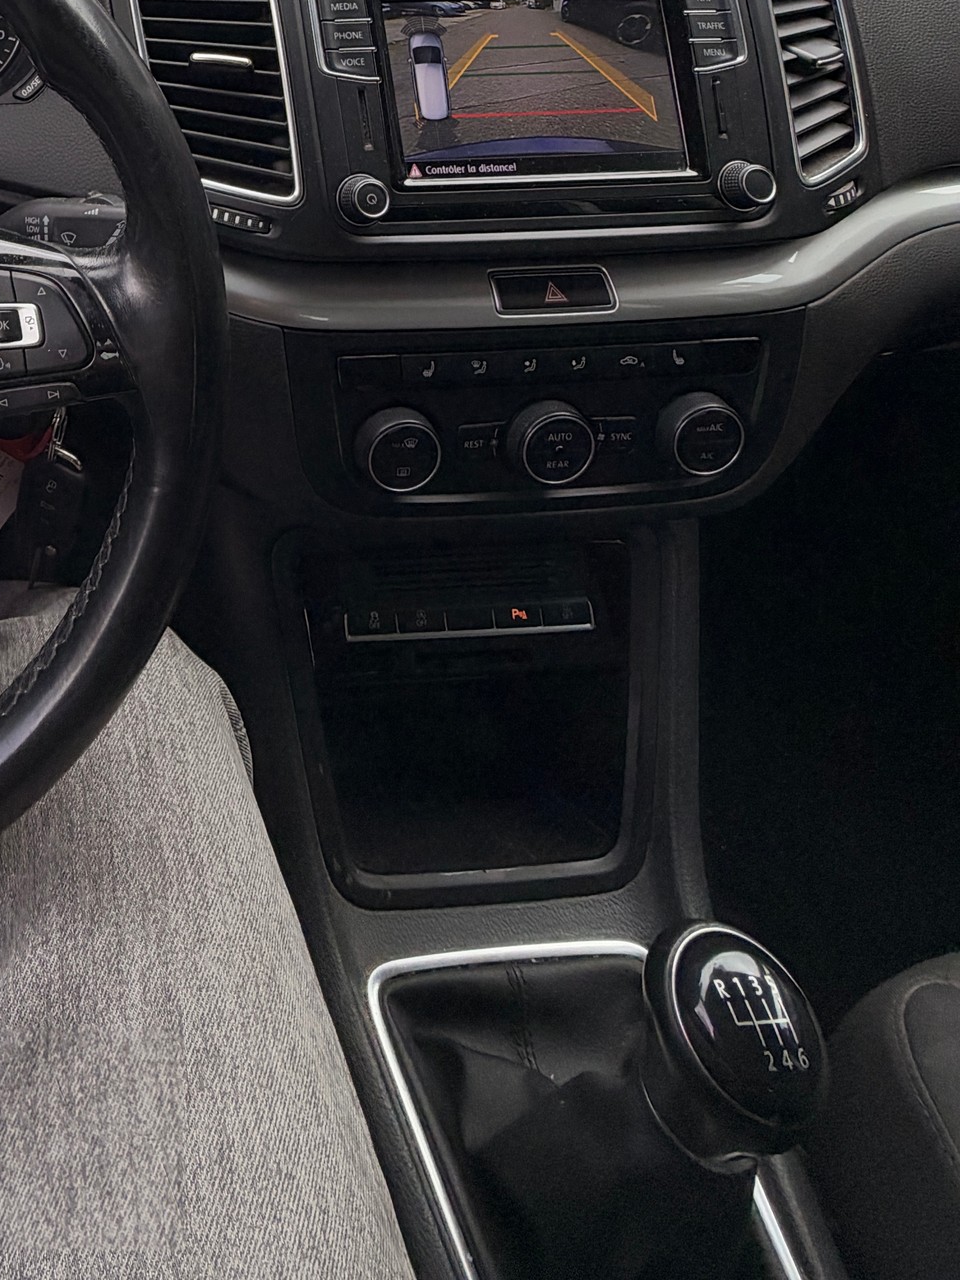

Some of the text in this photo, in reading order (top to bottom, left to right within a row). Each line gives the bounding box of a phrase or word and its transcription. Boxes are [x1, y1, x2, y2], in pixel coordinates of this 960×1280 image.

[330, 2, 358, 11] MEDIA
[697, 22, 725, 30] TRAFFIC
[333, 31, 363, 40] PHONE
[703, 48, 725, 56] MENU
[340, 58, 365, 66] VOICE
[21, 75, 41, 97] 0.0/SE
[467, 164, 476, 173] la
[26, 224, 40, 233] LOW
[548, 433, 572, 441] AUTO
[610, 432, 633, 441] SYNC
[464, 440, 484, 448] REST
[546, 460, 569, 469] REAR
[713, 979, 731, 999] R
[732, 977, 746, 997] 1
[748, 975, 763, 996] 3
[764, 1047, 810, 1071] 2 4 6
